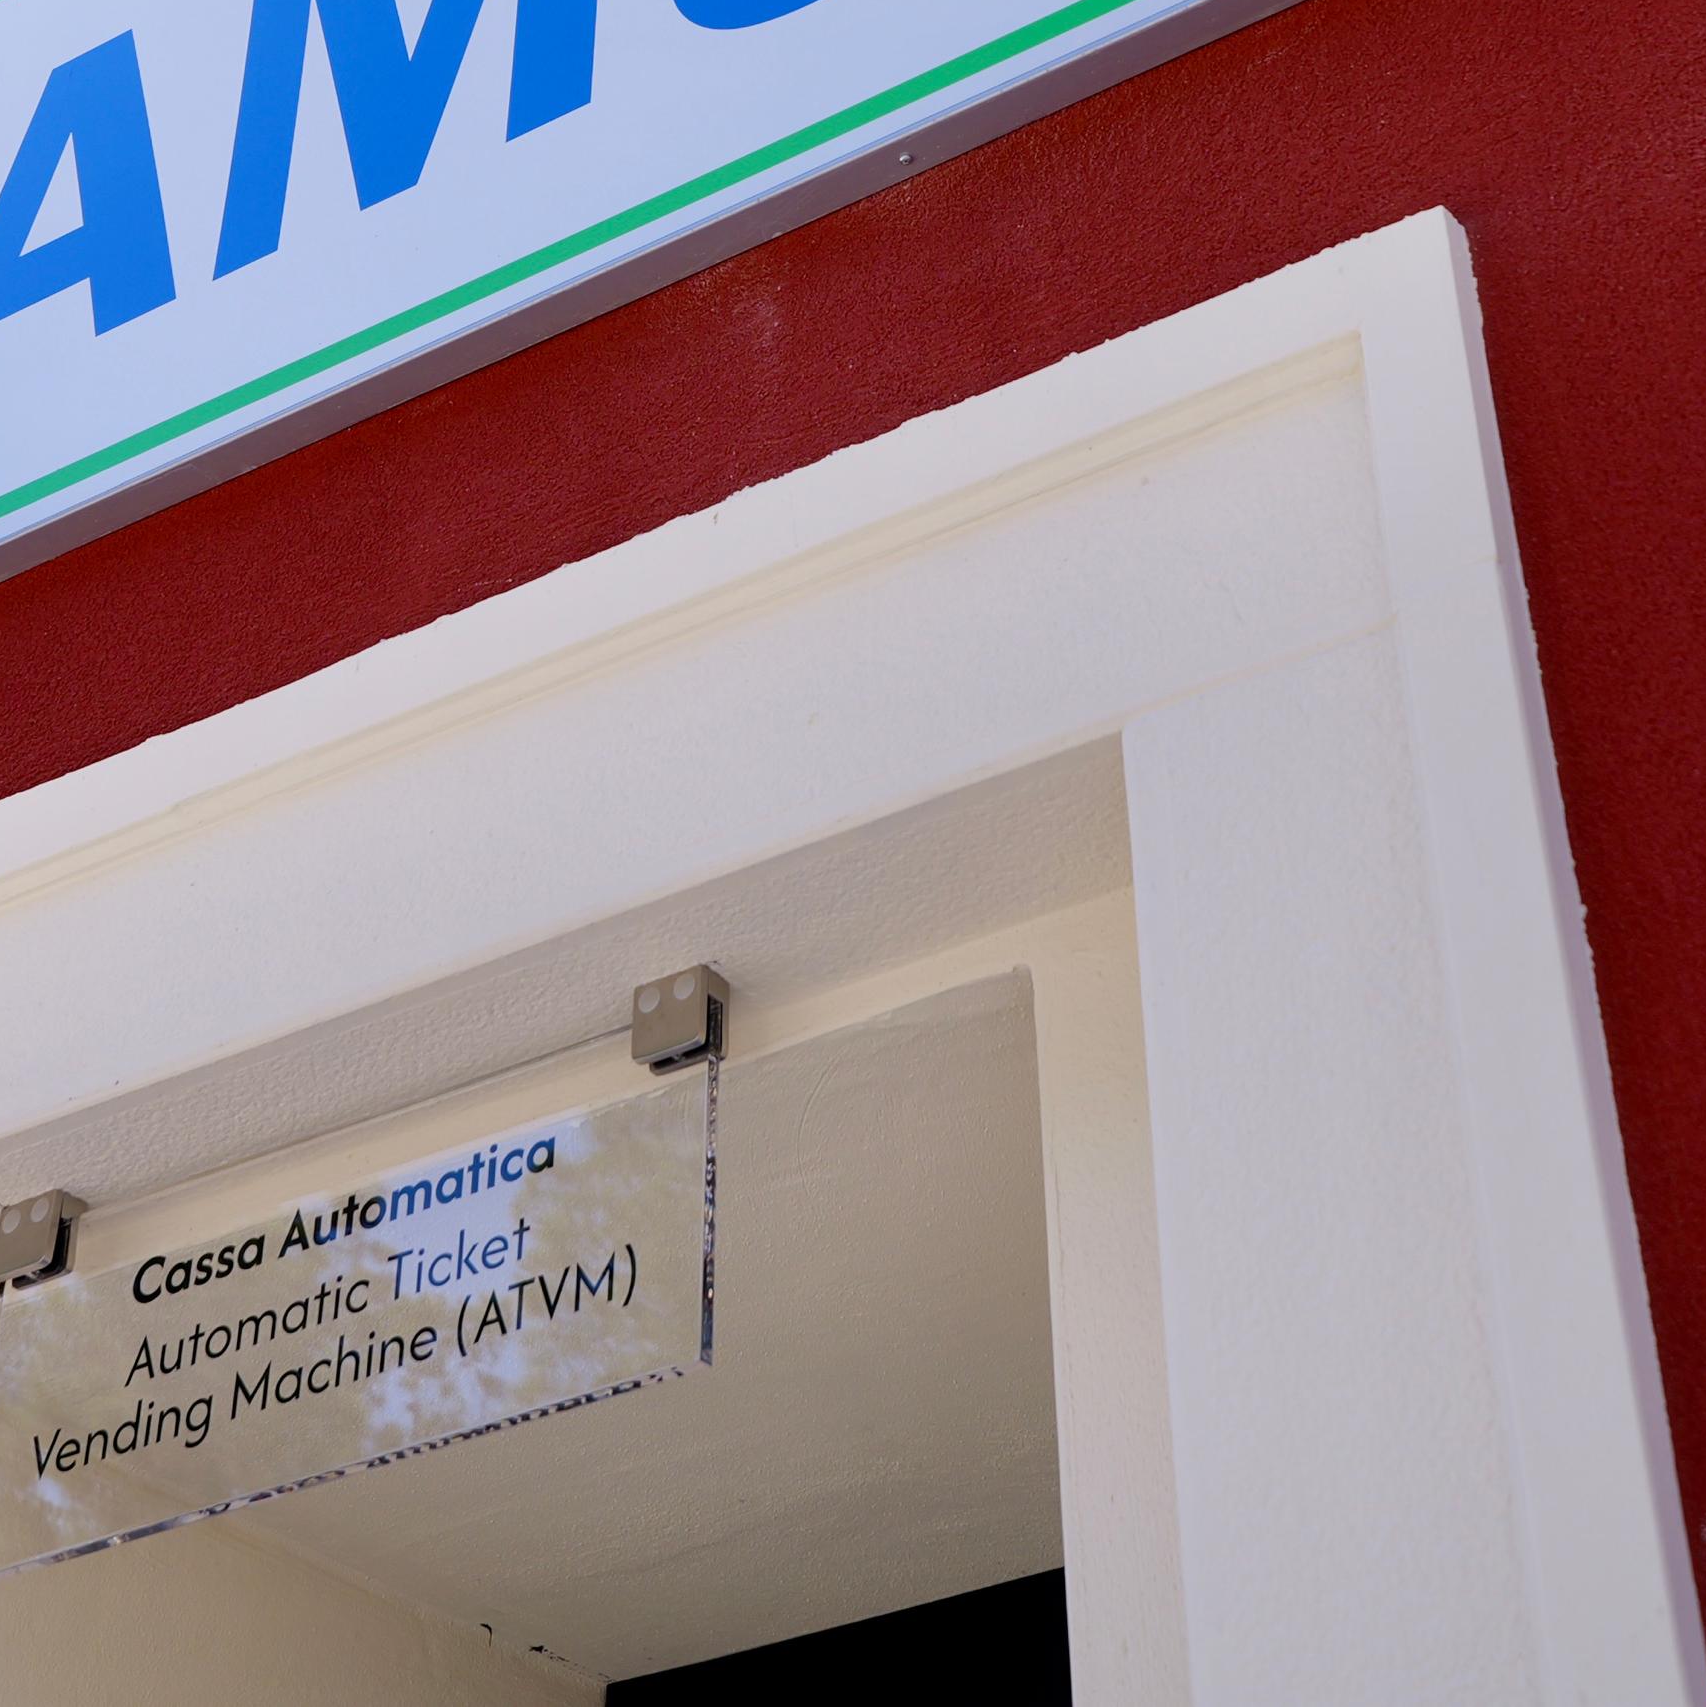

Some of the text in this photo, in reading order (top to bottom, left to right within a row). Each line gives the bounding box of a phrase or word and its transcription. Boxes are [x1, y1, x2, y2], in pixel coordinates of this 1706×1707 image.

[125, 1217, 532, 1386] Automatic Ticket
[131, 1135, 557, 1304] Cassa Automatica
[32, 1243, 638, 1478] Vending Machine (ATVM)
